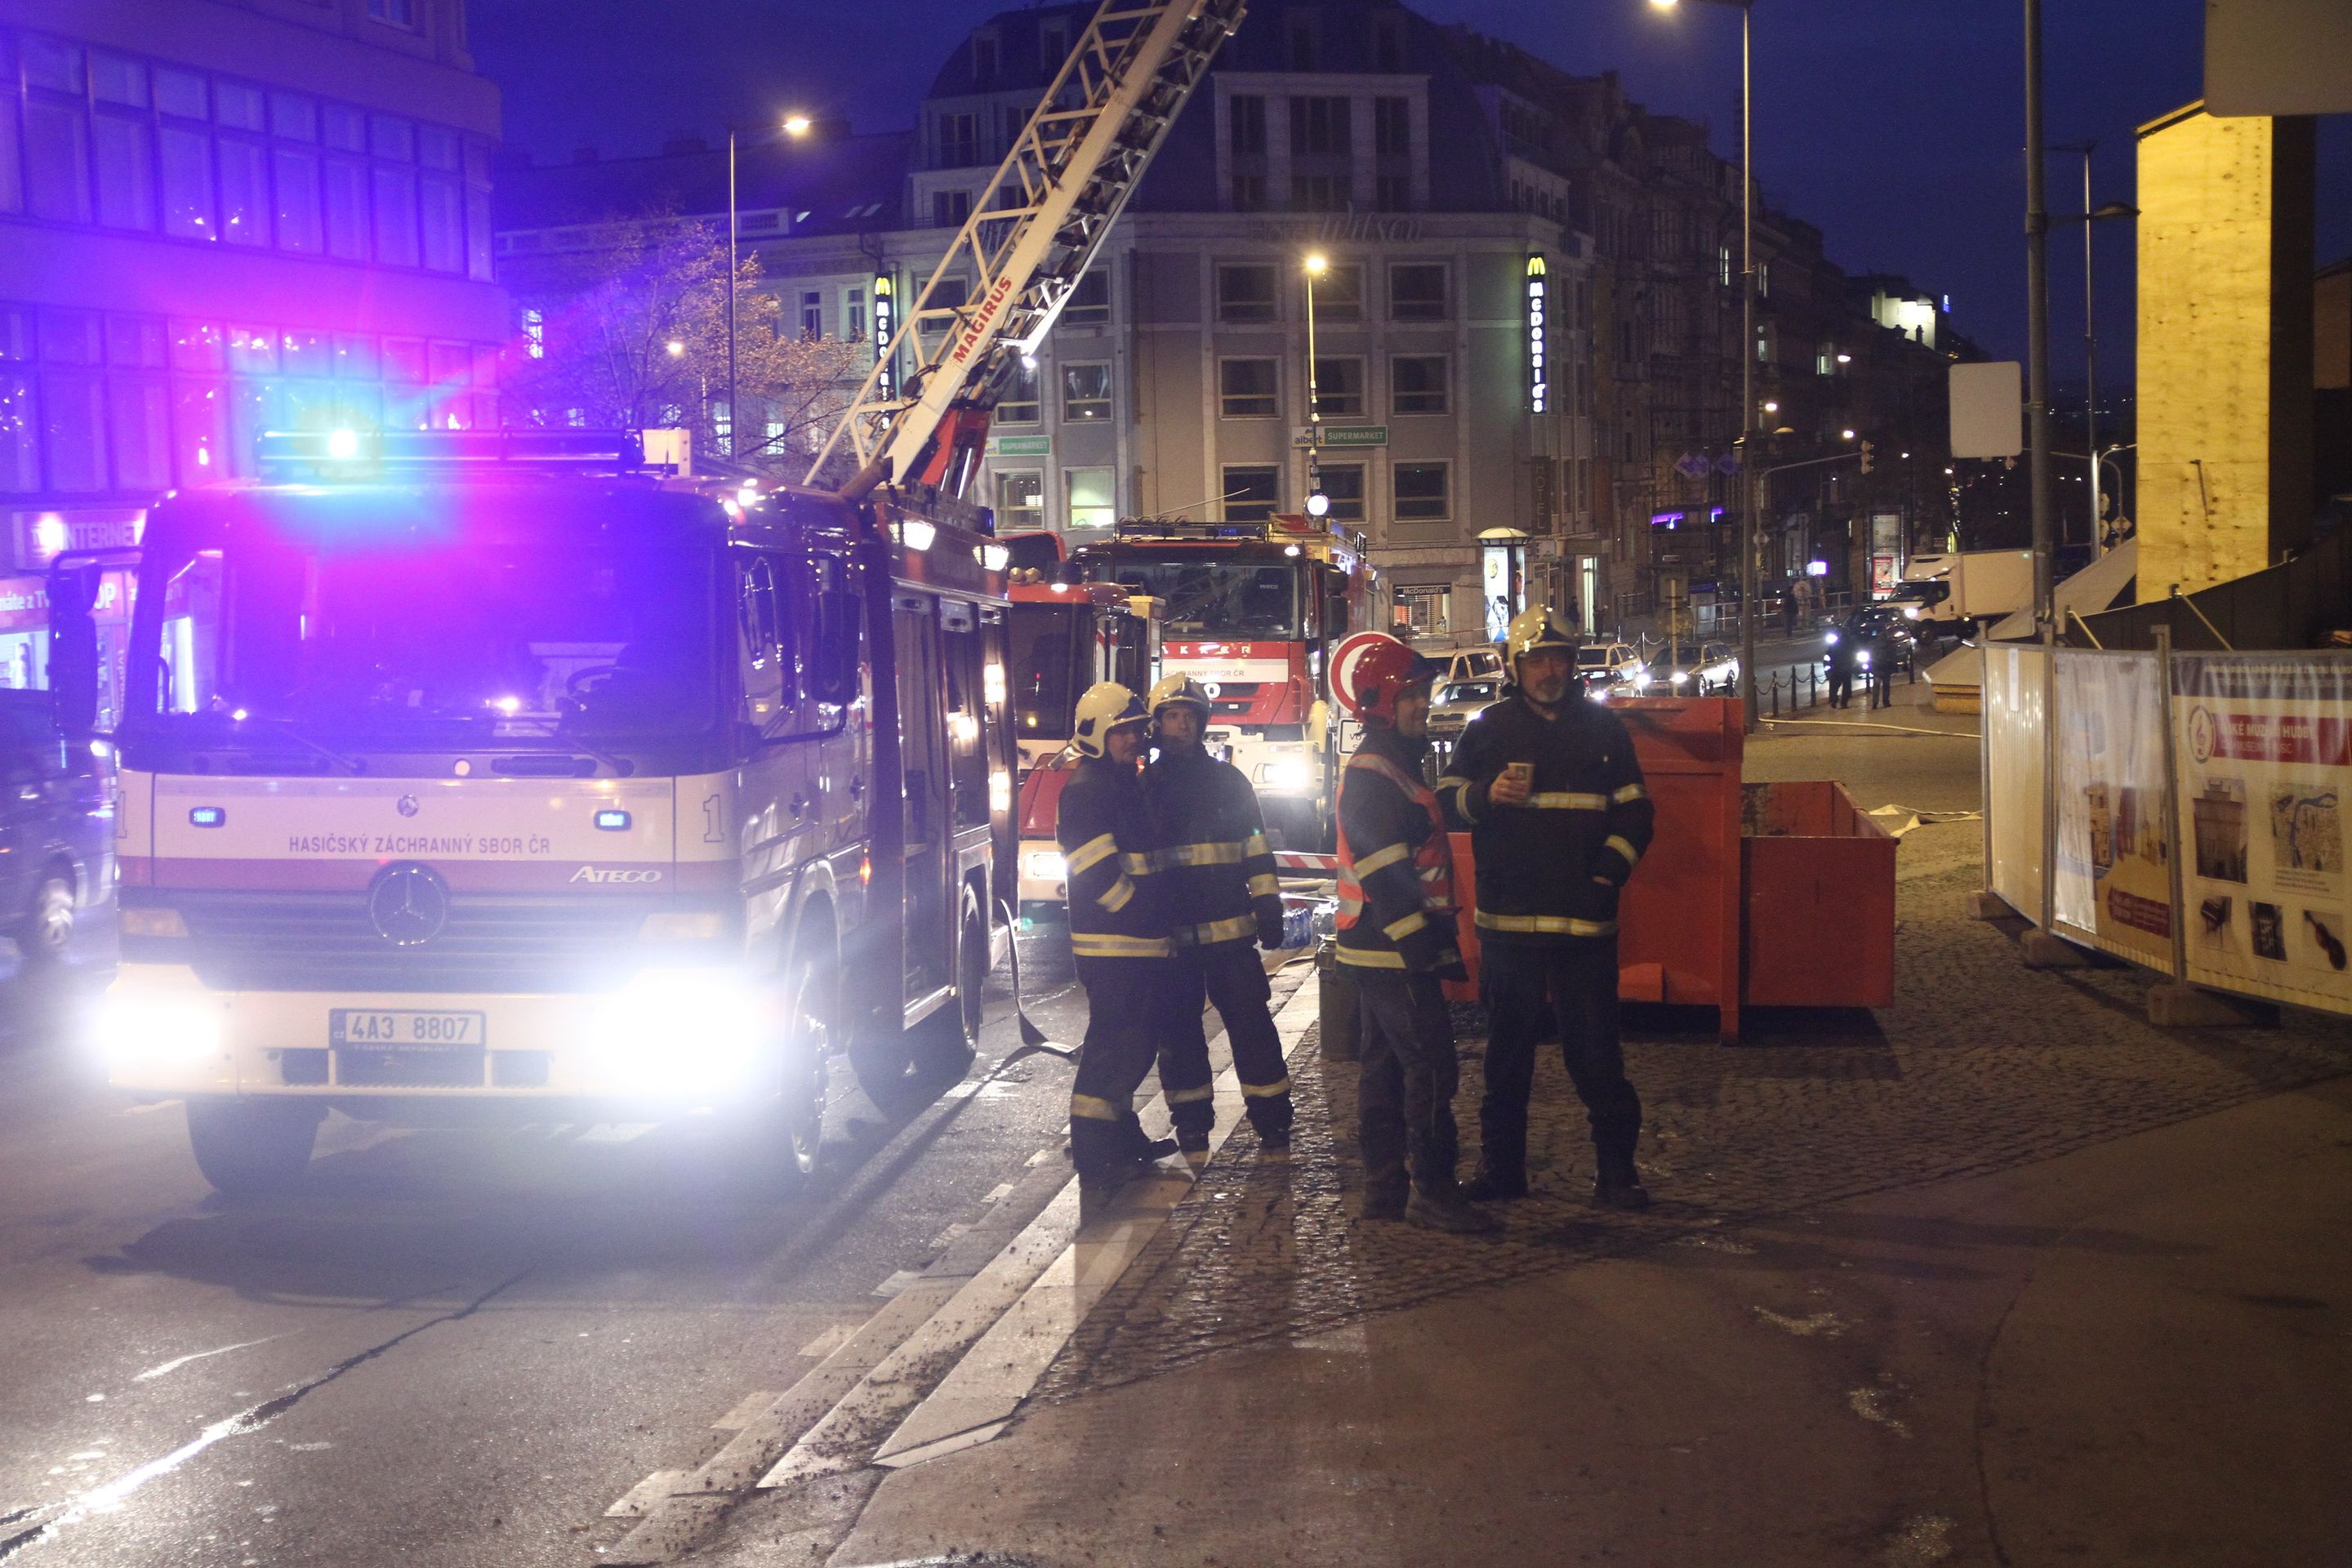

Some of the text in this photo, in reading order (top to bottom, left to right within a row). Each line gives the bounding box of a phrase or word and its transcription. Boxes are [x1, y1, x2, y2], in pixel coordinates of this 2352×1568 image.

[952, 276, 1013, 363] MAGIRUS
[1529, 282, 1546, 413] McDonald's
[1327, 431, 1384, 440] SUPERMARKET
[1535, 463, 1546, 530] HOTEL
[1402, 587, 1445, 595] McDonald's
[702, 794, 724, 843] 1
[288, 832, 550, 854] HASIČSKÝ ZÁCHRANNÝ SBOR ČR
[351, 1015, 394, 1040] 4A3
[412, 1016, 470, 1040] 8807
